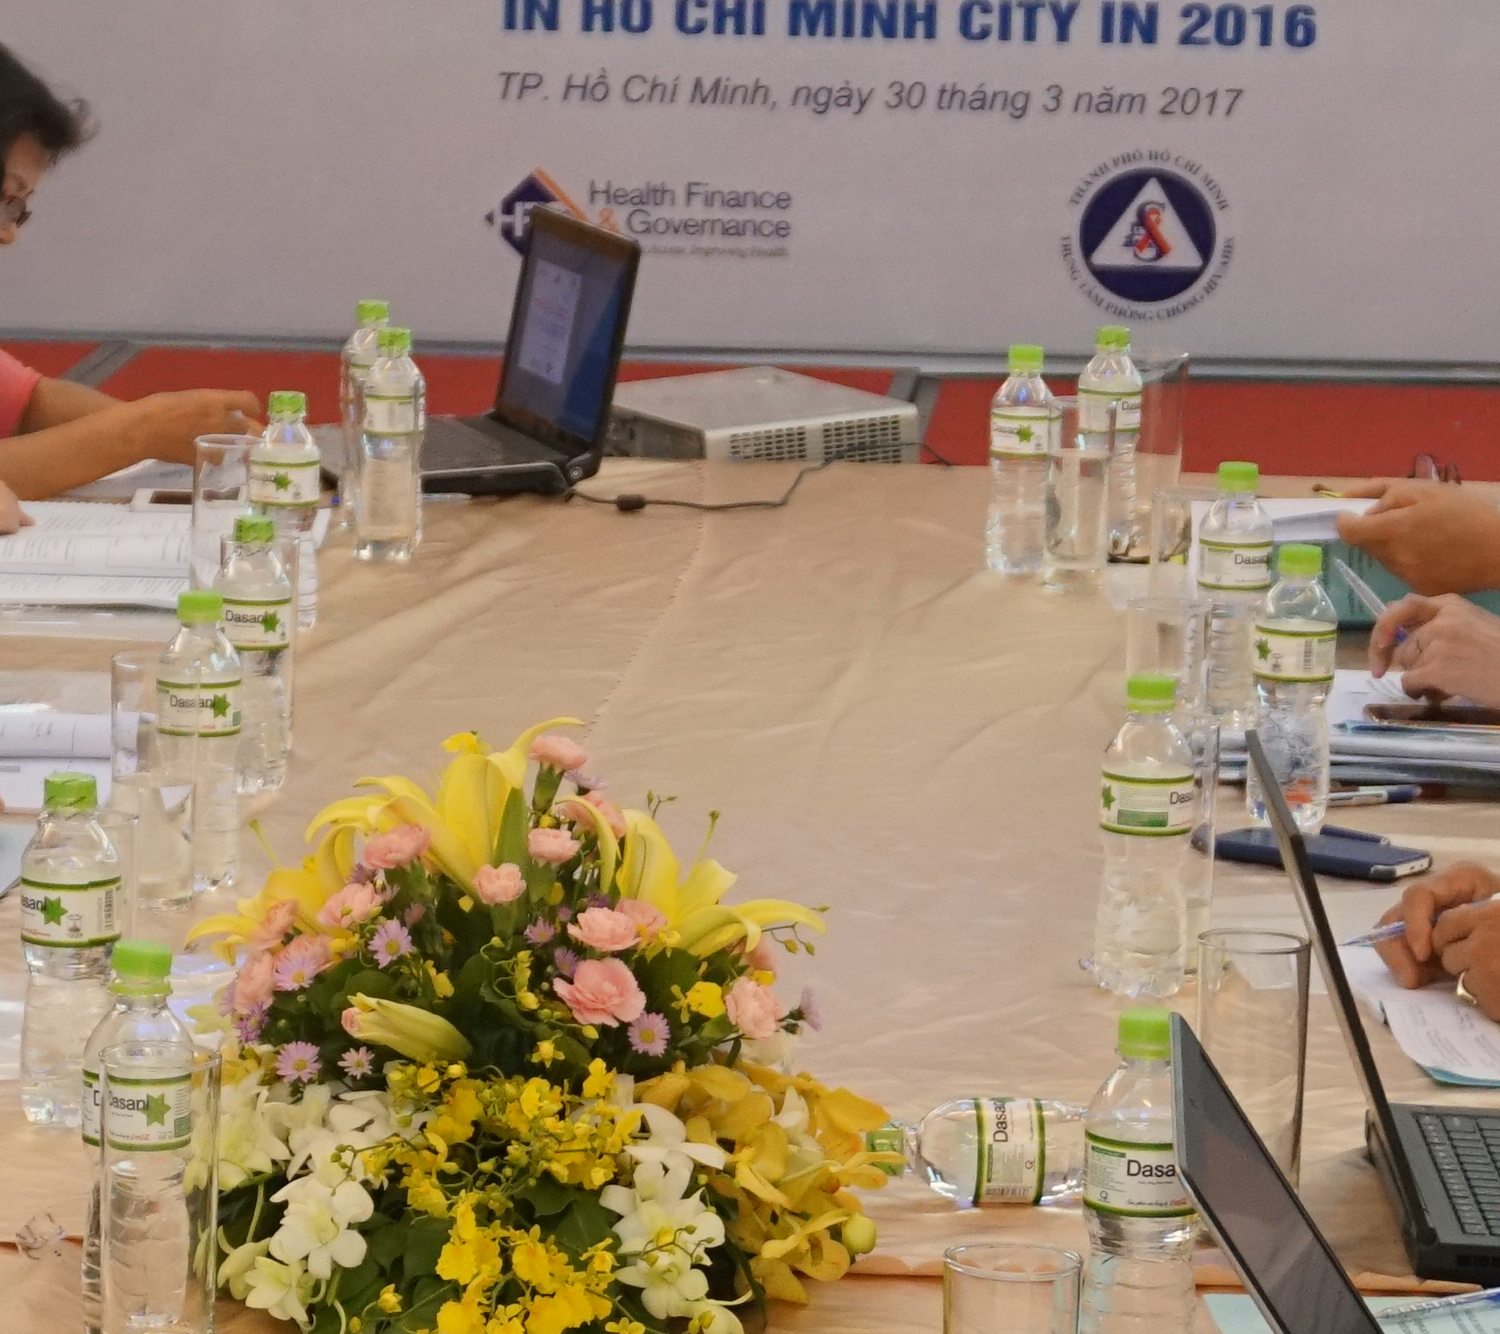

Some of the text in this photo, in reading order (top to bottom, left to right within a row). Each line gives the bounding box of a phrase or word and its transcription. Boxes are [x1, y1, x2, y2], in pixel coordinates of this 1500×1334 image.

[1101, 2, 1158, 45] IN
[1179, 4, 1316, 48] 2016
[499, 68, 1244, 120] TP. Hồ Chí Minh, ngày 30 tháng 3 năm 2017
[589, 181, 792, 210] Health Finance
[627, 209, 793, 239] Governance
